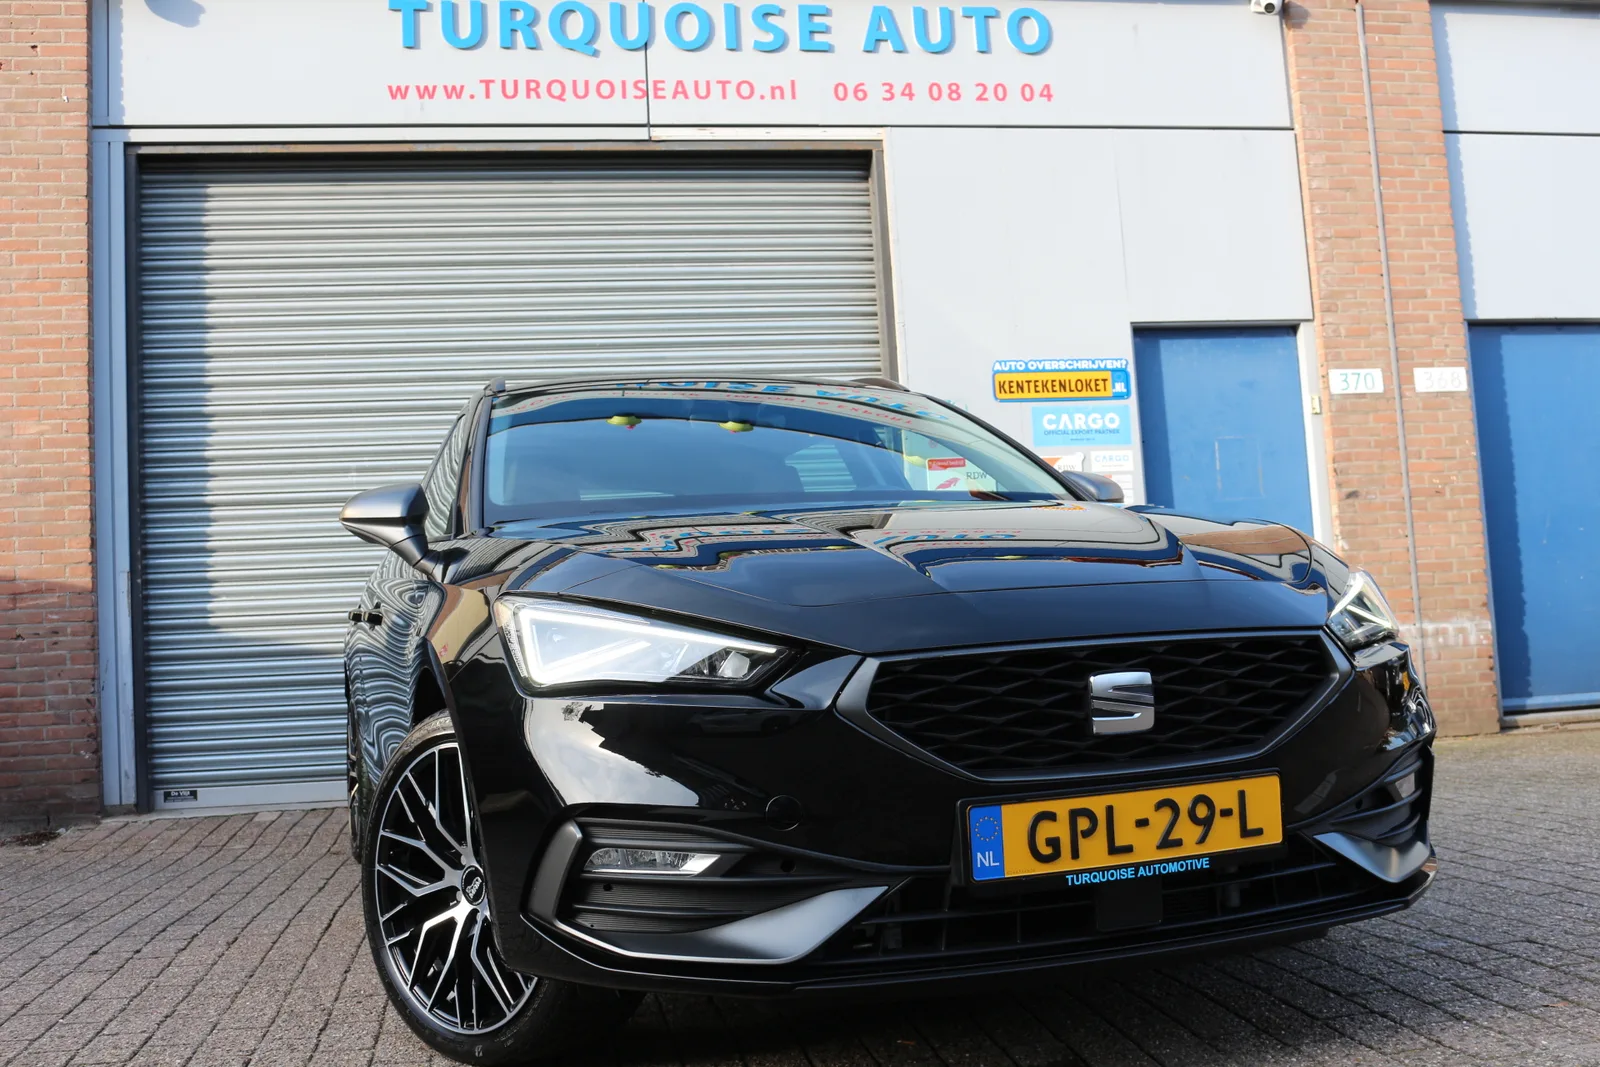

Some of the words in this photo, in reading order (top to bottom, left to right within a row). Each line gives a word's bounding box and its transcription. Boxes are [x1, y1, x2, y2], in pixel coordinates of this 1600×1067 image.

[388, 0, 833, 57] TURQUOISE
[863, 5, 1052, 55] AUTO
[387, 79, 798, 102] www.TURQUOISEAUTO.nl
[833, 82, 868, 101] 06
[881, 82, 915, 101] 34
[928, 83, 962, 102] 08
[975, 83, 1008, 102] 20
[1020, 83, 1054, 102] 04
[993, 361, 1025, 371] AUTO
[1028, 360, 1127, 371] OVERSCHRIJVEN?
[998, 378, 1108, 394] KENTEKENLOKET
[1339, 372, 1375, 391] 370
[1423, 371, 1462, 390] 368
[1042, 412, 1120, 430] CARGO
[1094, 454, 1130, 462] CARGO
[966, 471, 987, 480] RDW
[1027, 789, 1264, 864] GPL-29-L
[977, 852, 1000, 868] NL
[1065, 866, 1135, 886] TURQUOISE
[1137, 857, 1210, 877] AUTOMOTIVE
